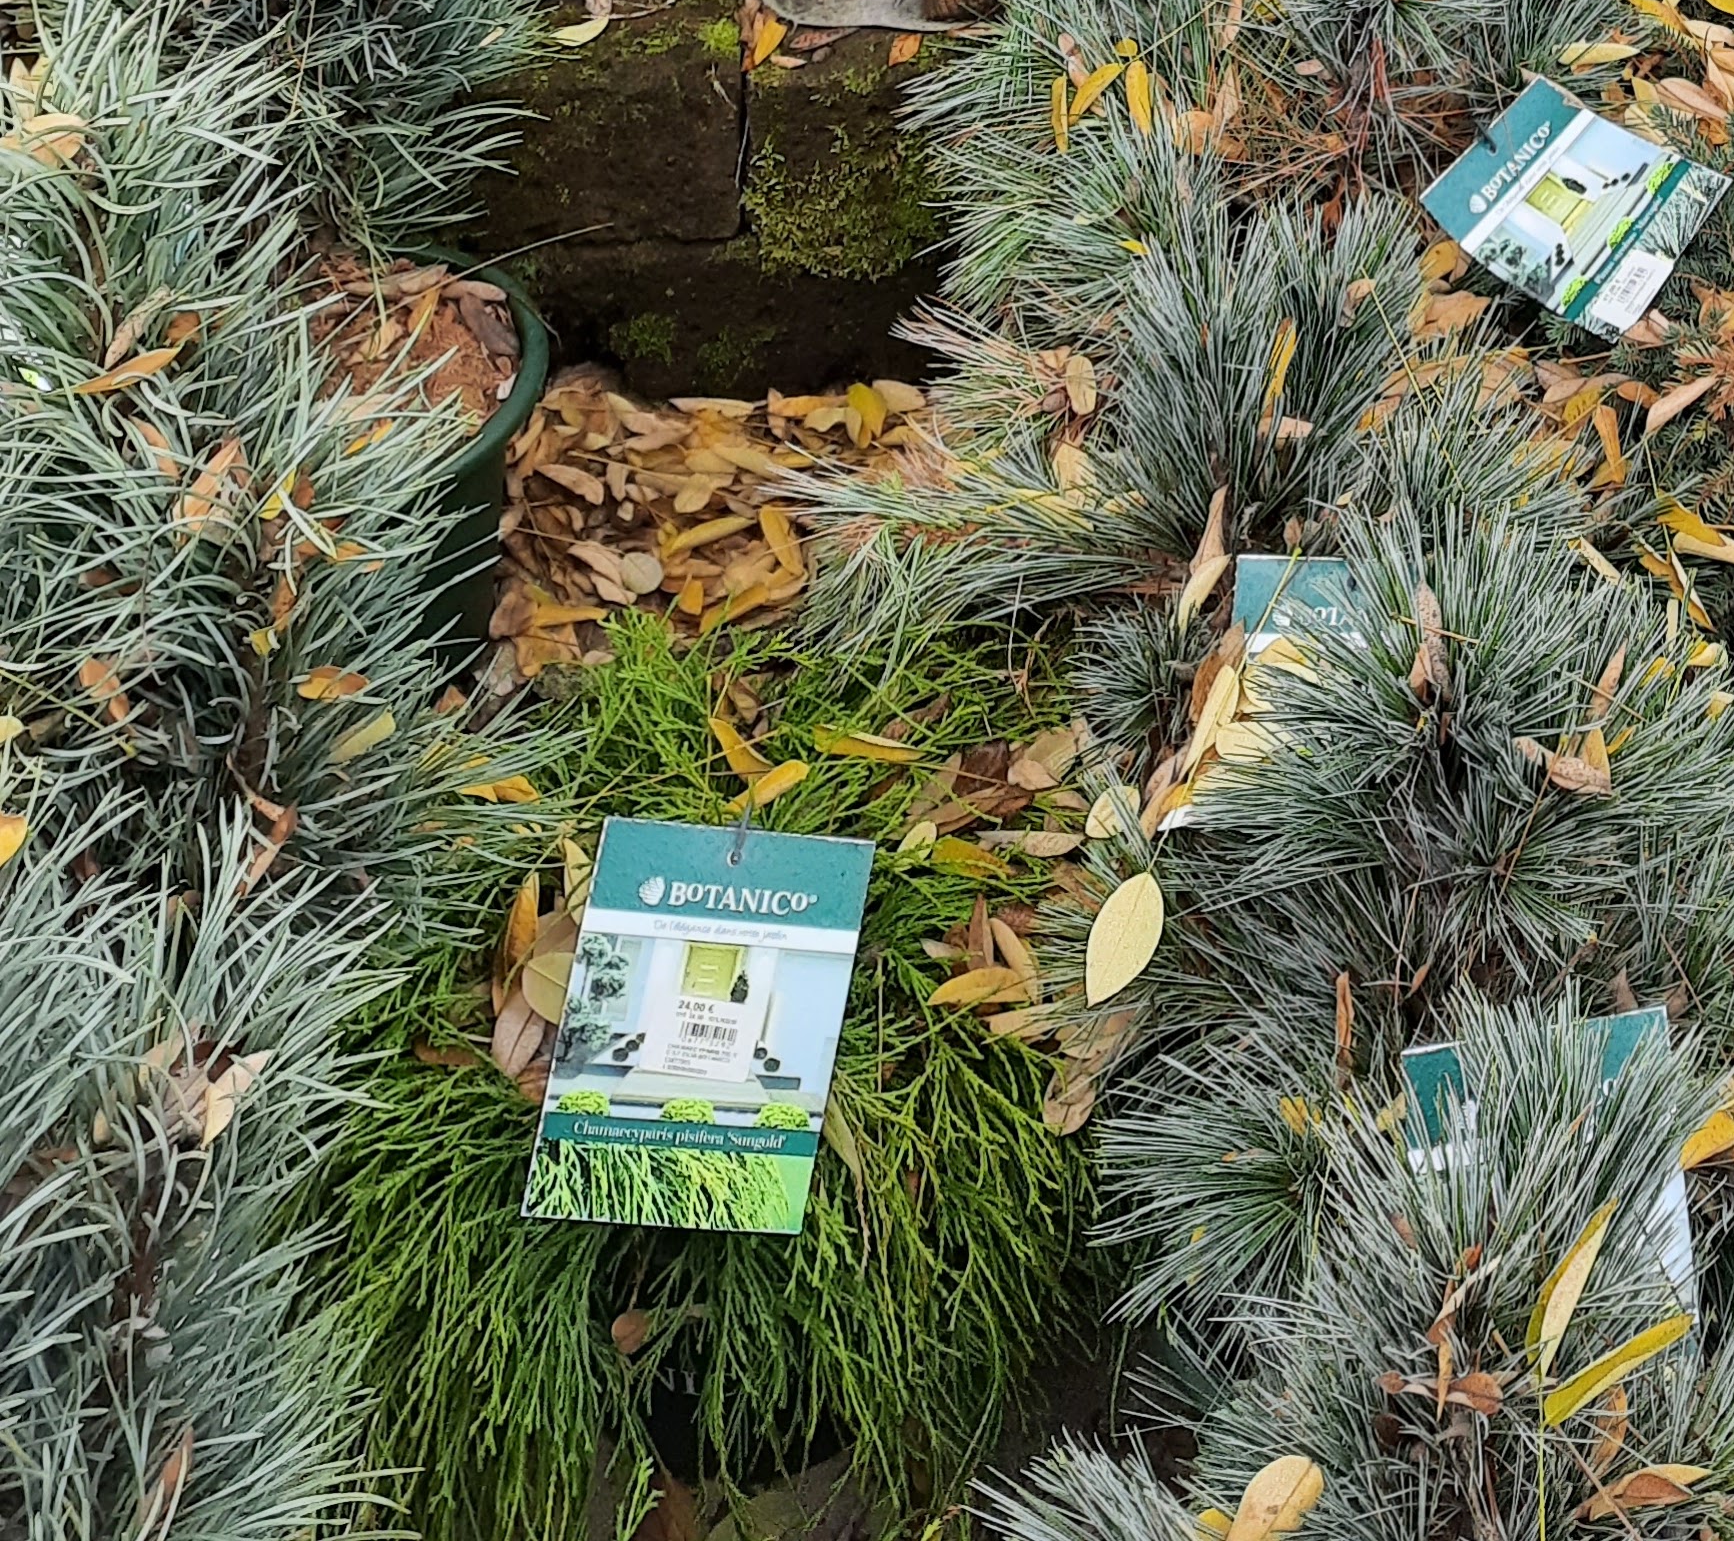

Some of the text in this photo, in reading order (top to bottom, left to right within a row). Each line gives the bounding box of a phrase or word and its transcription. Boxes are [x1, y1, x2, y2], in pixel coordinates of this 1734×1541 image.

[1481, 125, 1551, 202] BOTANICO
[667, 882, 811, 916] BOTANICO
[675, 1130, 724, 1146] pisifera
